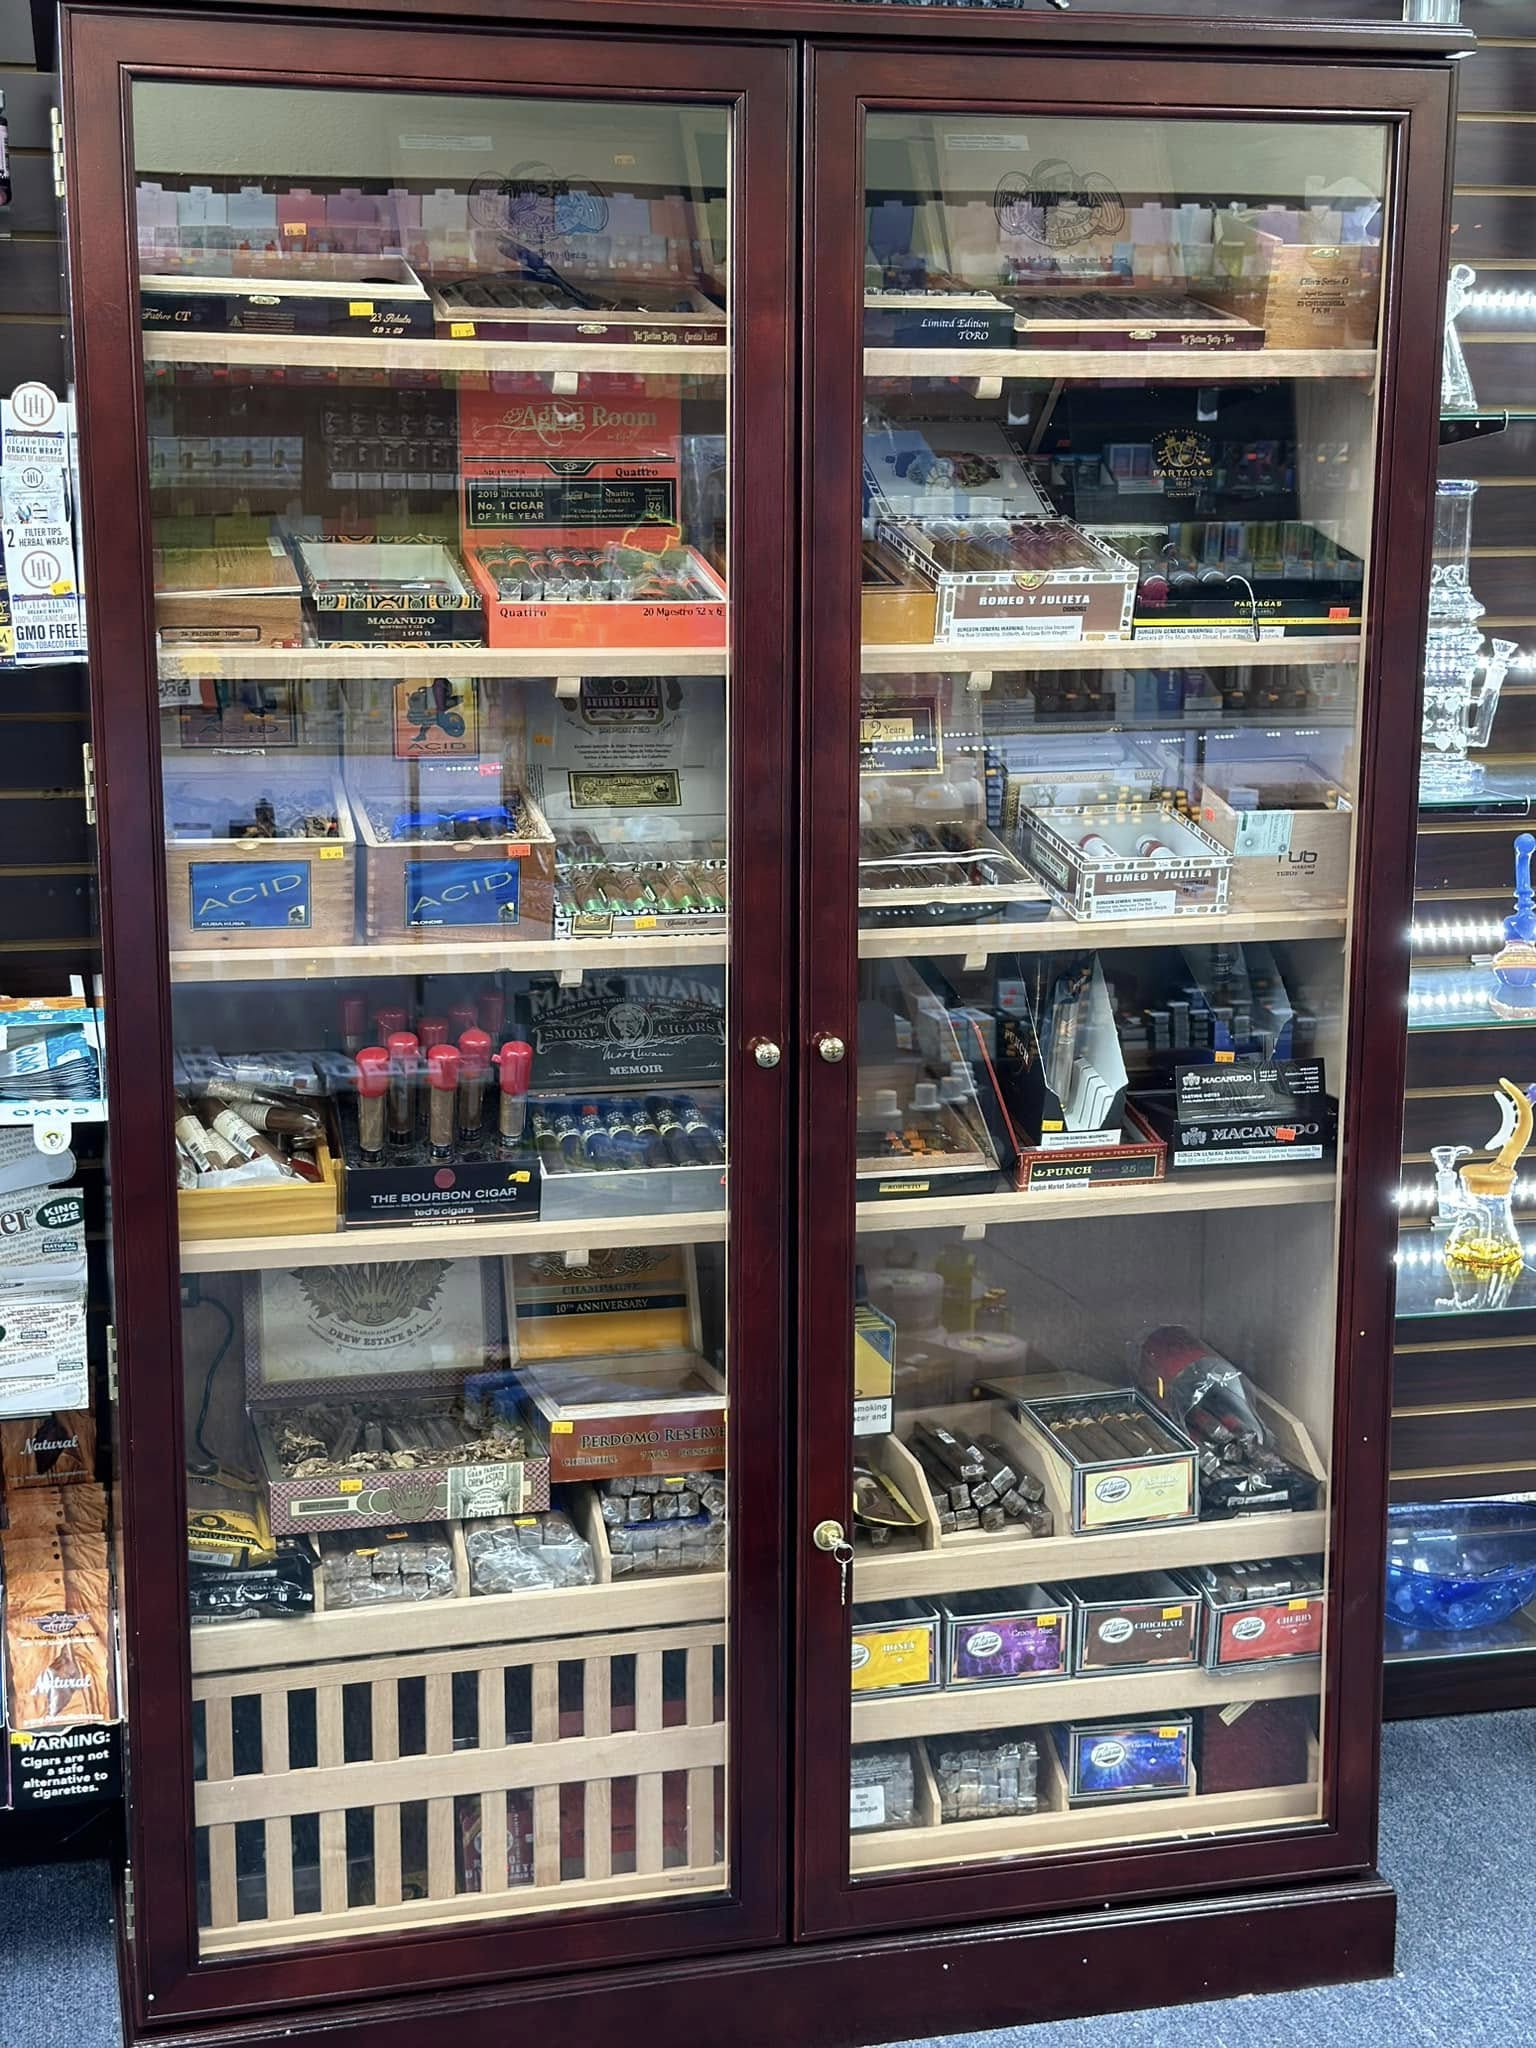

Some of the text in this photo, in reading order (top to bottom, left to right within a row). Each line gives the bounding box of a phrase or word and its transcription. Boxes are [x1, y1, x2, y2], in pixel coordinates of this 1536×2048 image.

[921, 317, 989, 328] Limited Edition
[957, 330, 989, 341] TORO
[523, 405, 657, 432] Agig Room
[7, 446, 62, 455] ORGANIC WRAPS
[615, 467, 658, 478] Quattro
[1153, 469, 1213, 477] PARTAGAS
[477, 490, 498, 498] 2019
[477, 501, 496, 511] No.
[509, 501, 544, 511] CIGAR
[648, 502, 661, 512] 96
[477, 511, 544, 521] OF THE YEAR
[6, 528, 15, 548] 2
[25, 528, 46, 536] FILTER
[19, 537, 69, 547] HERBAL WRAPS
[979, 594, 1091, 606] ROMEO Y JULIETA
[1234, 600, 1282, 608] PARTAGAS
[500, 607, 547, 618] Quattro
[643, 607, 654, 617] 20
[656, 606, 694, 617] Maestro
[367, 616, 435, 625] MACANUDO
[16, 624, 78, 640] GMO FREE
[860, 720, 906, 740] 12 Years
[408, 742, 466, 750] ACID
[1105, 869, 1212, 883] ROMEO Y JULIETA
[199, 874, 302, 916] ACID
[412, 871, 513, 914] ACID
[530, 977, 613, 1016] MARK
[622, 975, 722, 1007] TWAIN
[544, 1021, 716, 1041] SMOKE CIGARS
[610, 1064, 664, 1076] MEMOIR
[1202, 1074, 1252, 1084] MACANUDO
[1211, 1122, 1320, 1141] MACANDO
[1046, 1164, 1136, 1177] PUNCH 25
[1030, 1181, 1088, 1192] English Market Selection
[371, 1194, 398, 1204] THE
[401, 1190, 471, 1202] BOURBON
[44, 1201, 81, 1226] KING SIZE
[414, 1206, 474, 1216] ted's cigars
[576, 1298, 649, 1312] ANNIVERSARY
[328, 1327, 361, 1345] DREW
[364, 1333, 405, 1346] ESTATE
[872, 1412, 887, 1421] and
[582, 1426, 726, 1449] PERDOMO RESERVE
[20, 1434, 80, 1456] Natural
[485, 1472, 504, 1484] ESTATE
[1135, 1618, 1185, 1629] CHOCOLATE
[1277, 1613, 1312, 1625] CHERRY
[883, 1641, 917, 1652] HONEY
[30, 1666, 92, 1696] Natural
[20, 1731, 111, 1752] WARNING:
[21, 1750, 110, 1770] Cigars are not
[46, 1763, 84, 1777] a safe
[23, 1772, 108, 1789] alternative to
[32, 1784, 100, 1800] cigarettes.
